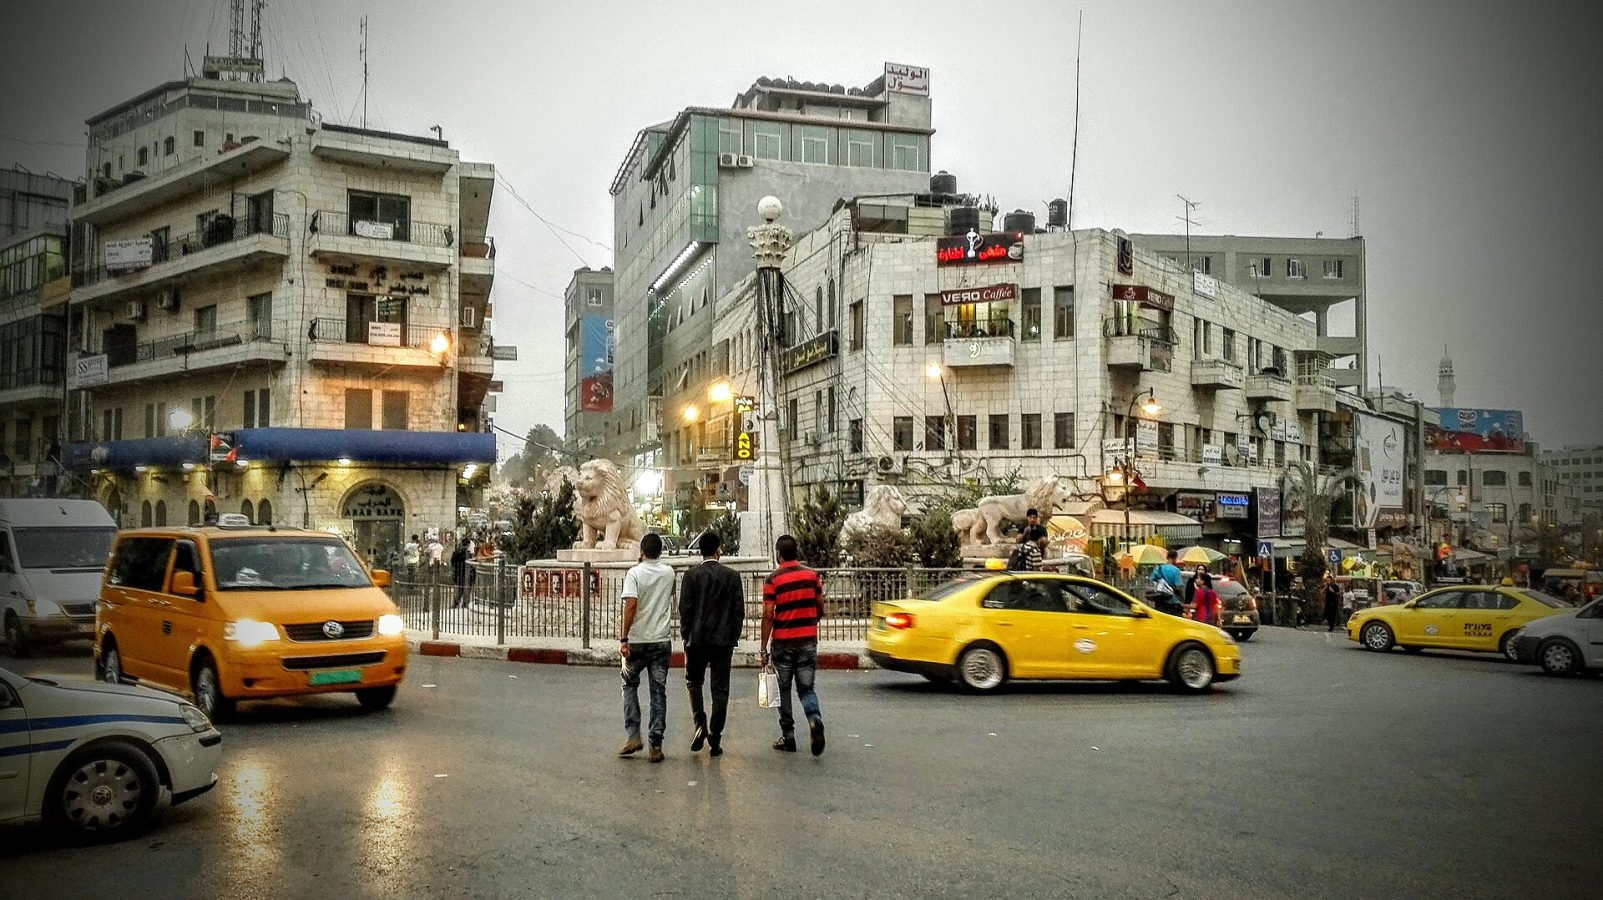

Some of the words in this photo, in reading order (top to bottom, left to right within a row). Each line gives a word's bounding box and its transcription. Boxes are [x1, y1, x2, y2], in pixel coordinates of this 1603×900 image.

[887, 66, 927, 80] الوليد
[942, 291, 980, 304] VERO
[344, 508, 371, 516] ARAB
[376, 508, 402, 516] BANK
